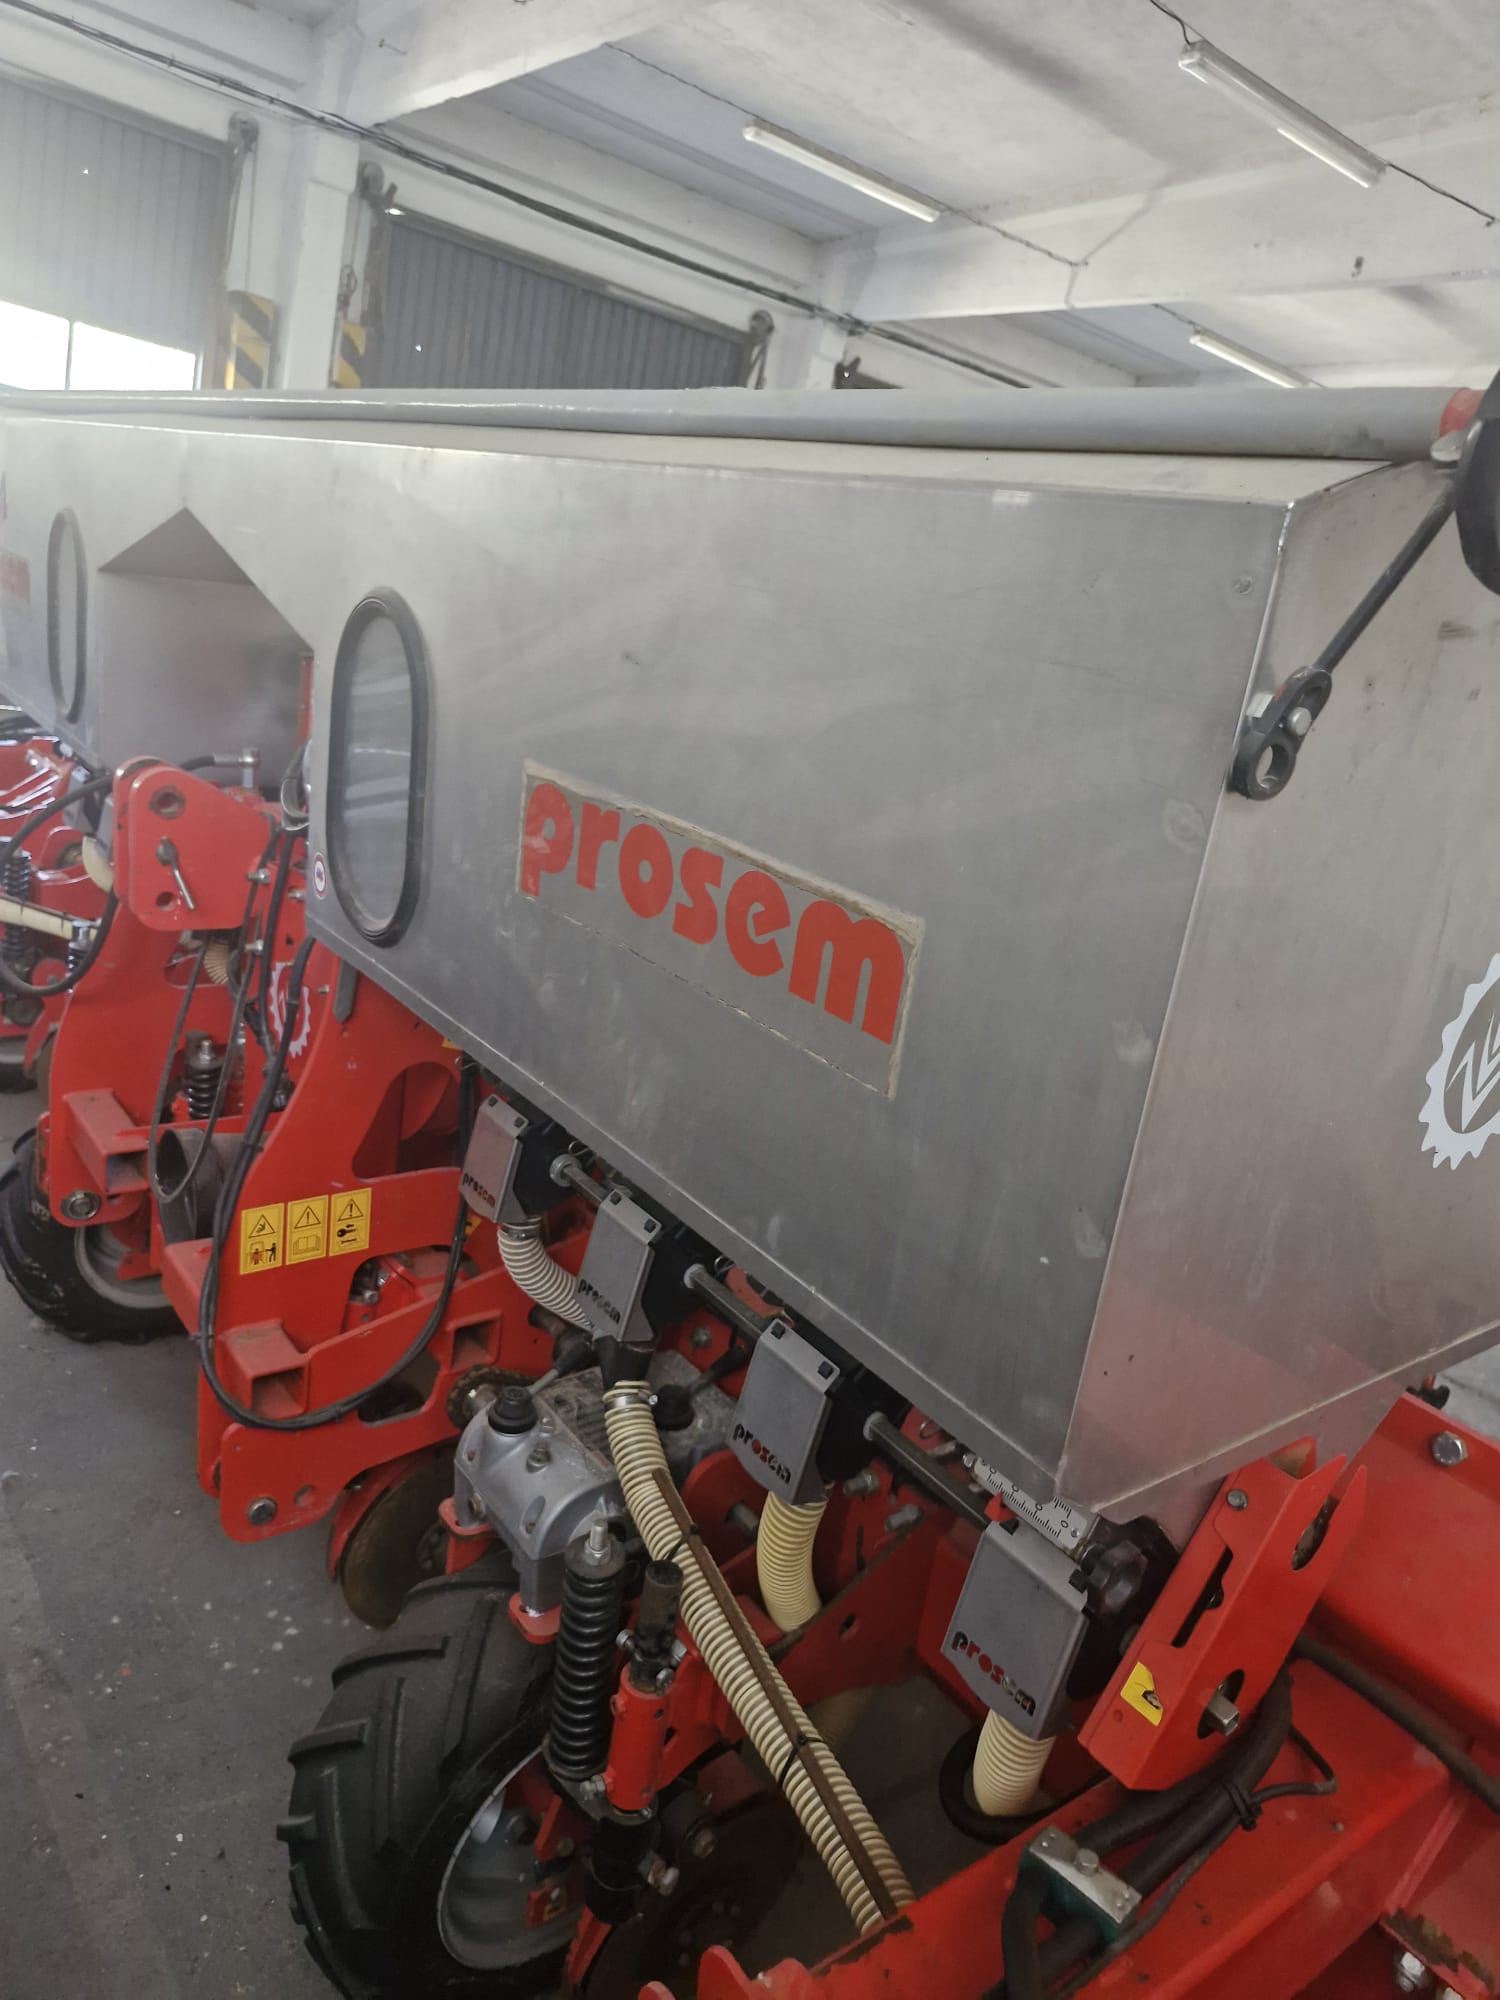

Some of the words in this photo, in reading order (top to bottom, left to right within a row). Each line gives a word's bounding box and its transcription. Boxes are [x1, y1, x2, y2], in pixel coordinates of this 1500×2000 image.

[520, 783, 905, 1045] prosem
[463, 1172, 496, 1209] prosem
[578, 1278, 621, 1325] prosem
[733, 1423, 792, 1485] prosem
[951, 1630, 1037, 1718] prosem
